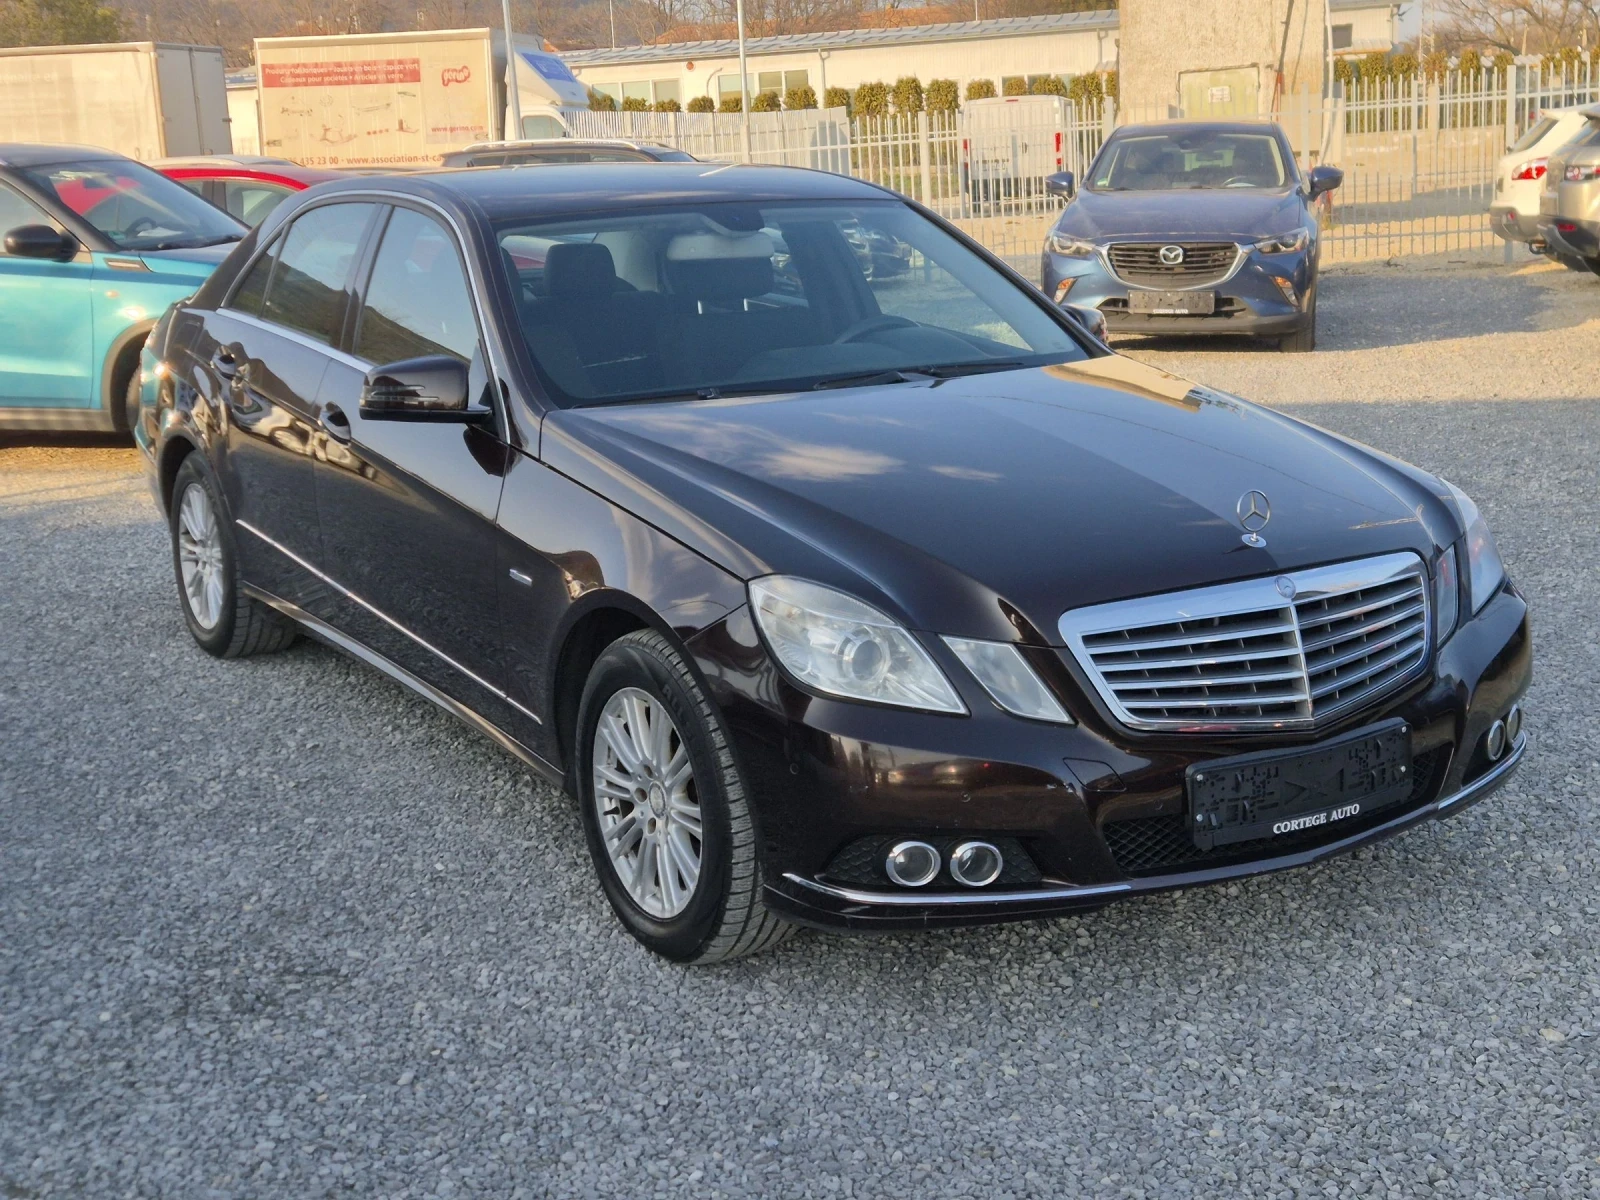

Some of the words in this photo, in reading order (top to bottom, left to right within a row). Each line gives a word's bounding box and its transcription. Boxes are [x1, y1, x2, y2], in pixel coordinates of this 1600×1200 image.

[307, 75, 322, 83] pour
[317, 156, 327, 165] 23
[329, 156, 339, 165] 00
[1272, 813, 1327, 834] CORTEGE
[1330, 803, 1360, 822] AUTO
